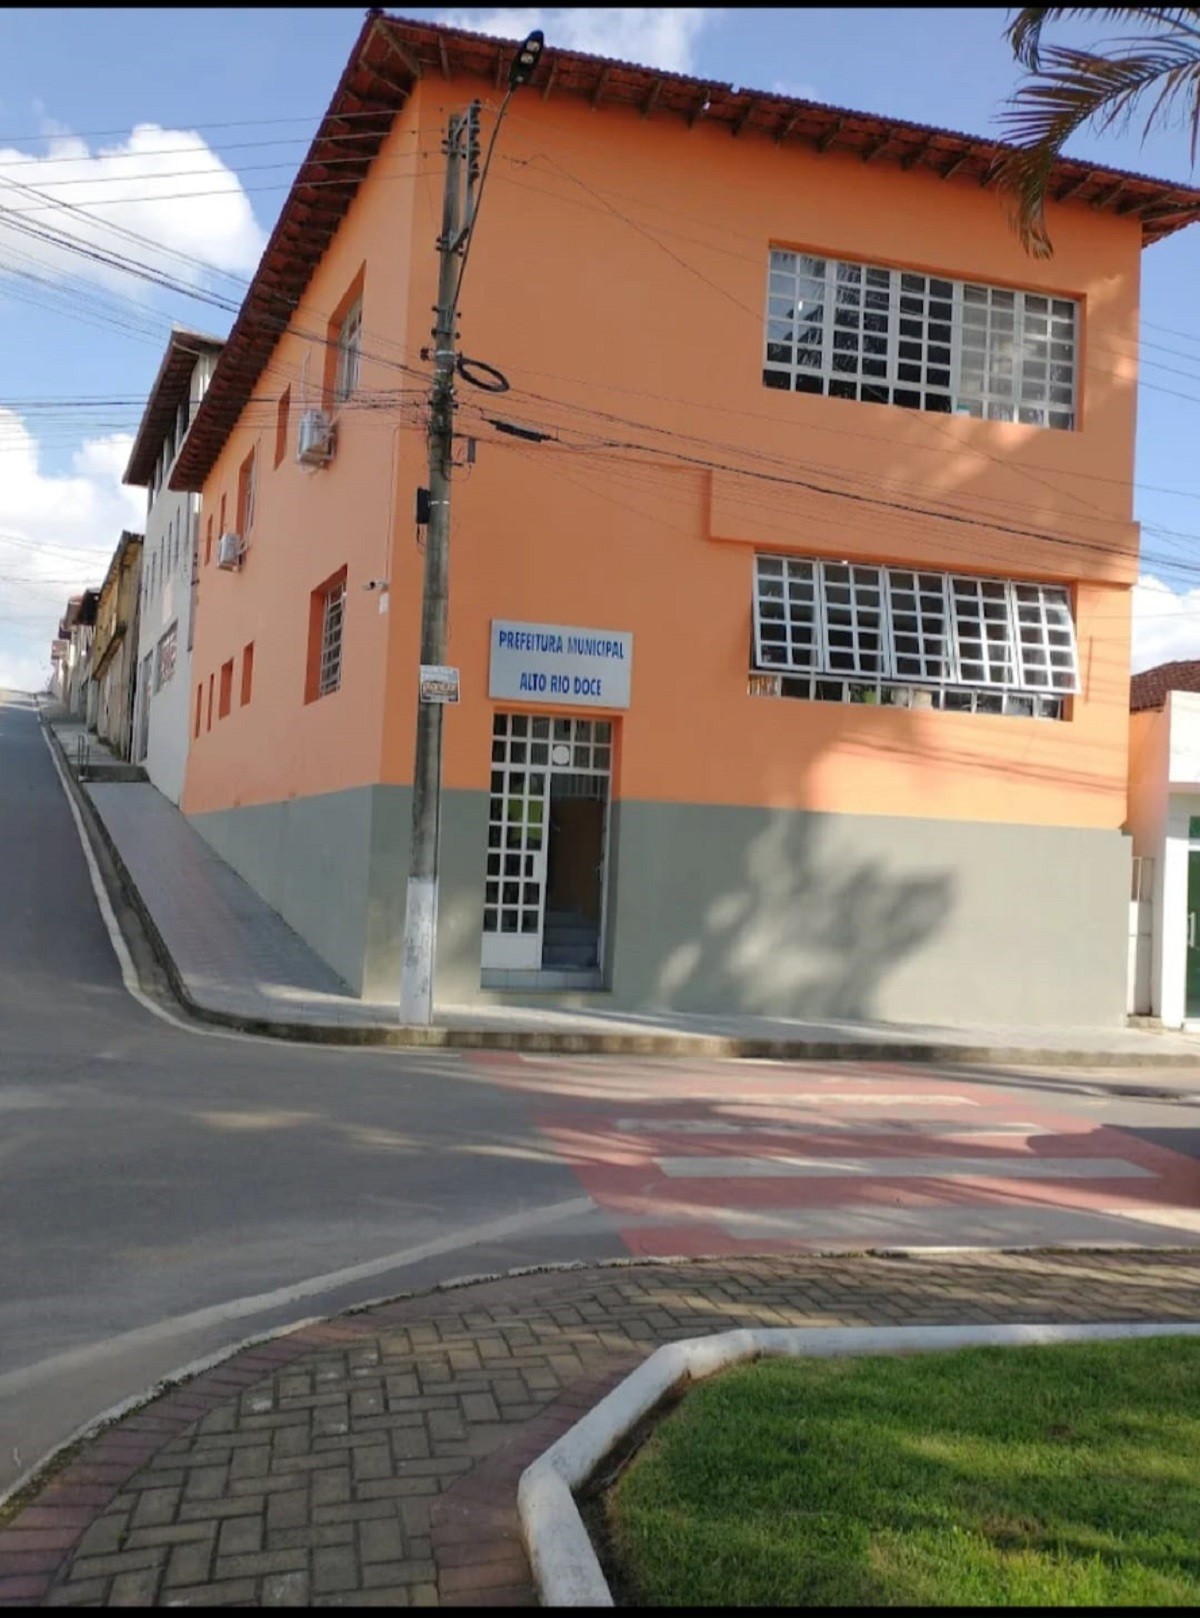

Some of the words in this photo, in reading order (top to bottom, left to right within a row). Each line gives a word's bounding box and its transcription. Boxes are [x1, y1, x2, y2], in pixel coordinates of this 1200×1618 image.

[499, 630, 563, 653] PREFEITURA
[567, 637, 624, 659] MUNICIPAL
[519, 672, 547, 692] ALTO
[550, 675, 570, 694] RIO
[573, 676, 602, 696] DOCE
